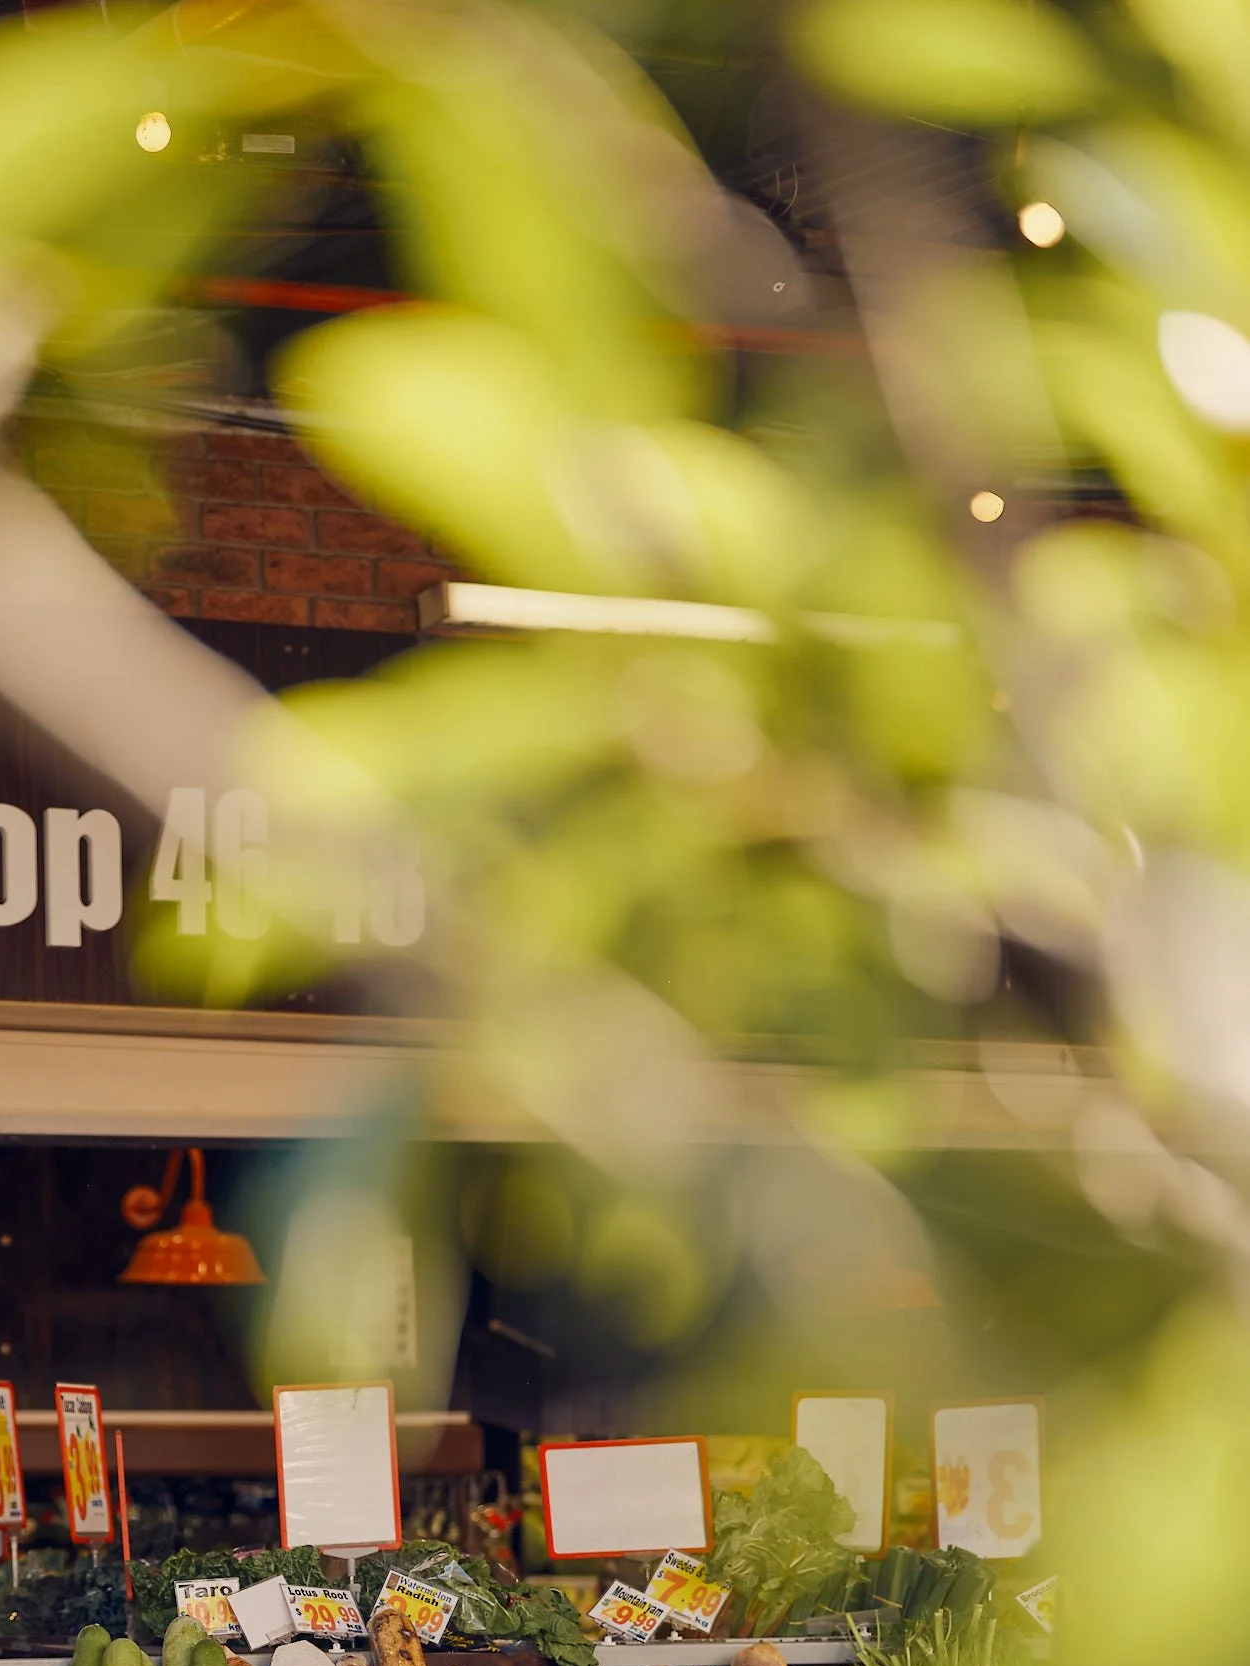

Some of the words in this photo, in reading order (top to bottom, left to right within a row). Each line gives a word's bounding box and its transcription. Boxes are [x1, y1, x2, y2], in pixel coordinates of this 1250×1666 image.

[665, 1552, 695, 1575] Swedes
[178, 1584, 233, 1600] Taro
[287, 1586, 318, 1598] Lotus
[323, 1589, 349, 1600] Root
[396, 1586, 439, 1607] Radish
[399, 1576, 452, 1603] Watermelon
[612, 1586, 647, 1610] Mountain
[645, 1603, 664, 1618] yam
